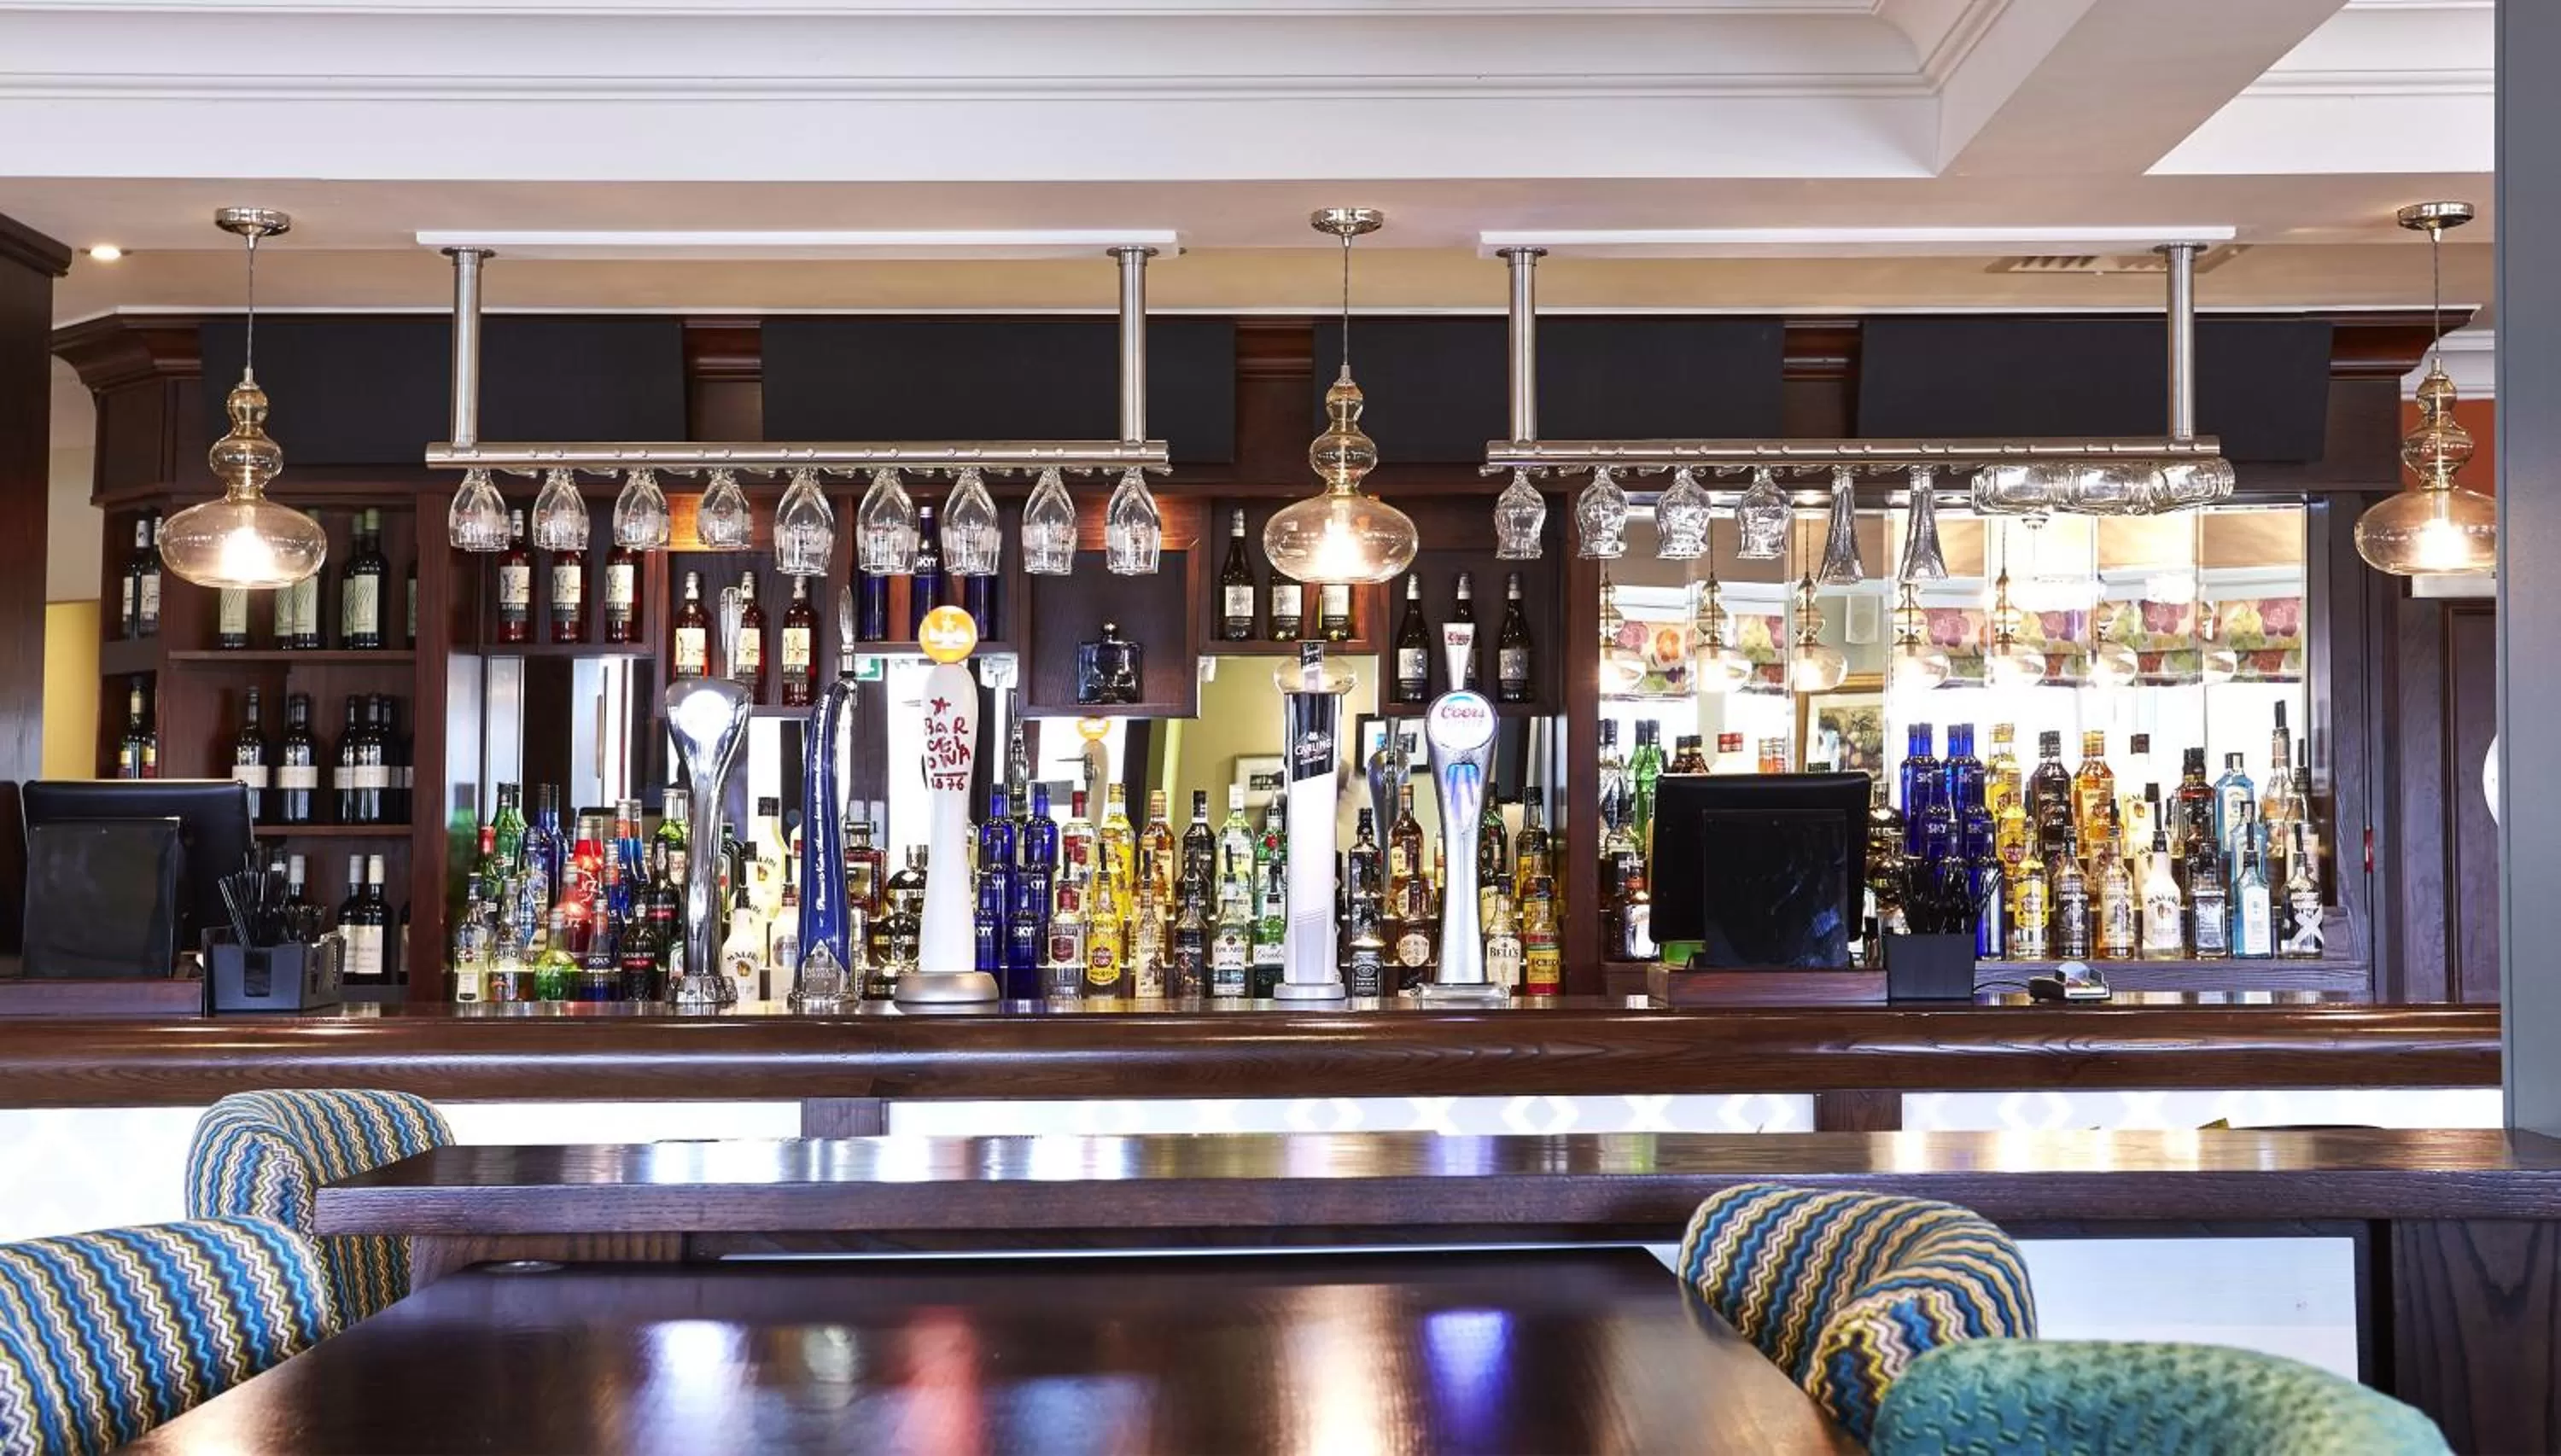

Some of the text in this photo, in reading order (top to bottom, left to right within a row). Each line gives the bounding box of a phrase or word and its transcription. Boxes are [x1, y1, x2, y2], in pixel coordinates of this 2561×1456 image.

[1441, 704, 1485, 719] Coors
[1294, 738, 1333, 755] CARLING
[930, 778, 965, 790] 1876
[1012, 926, 1037, 938] SKYY
